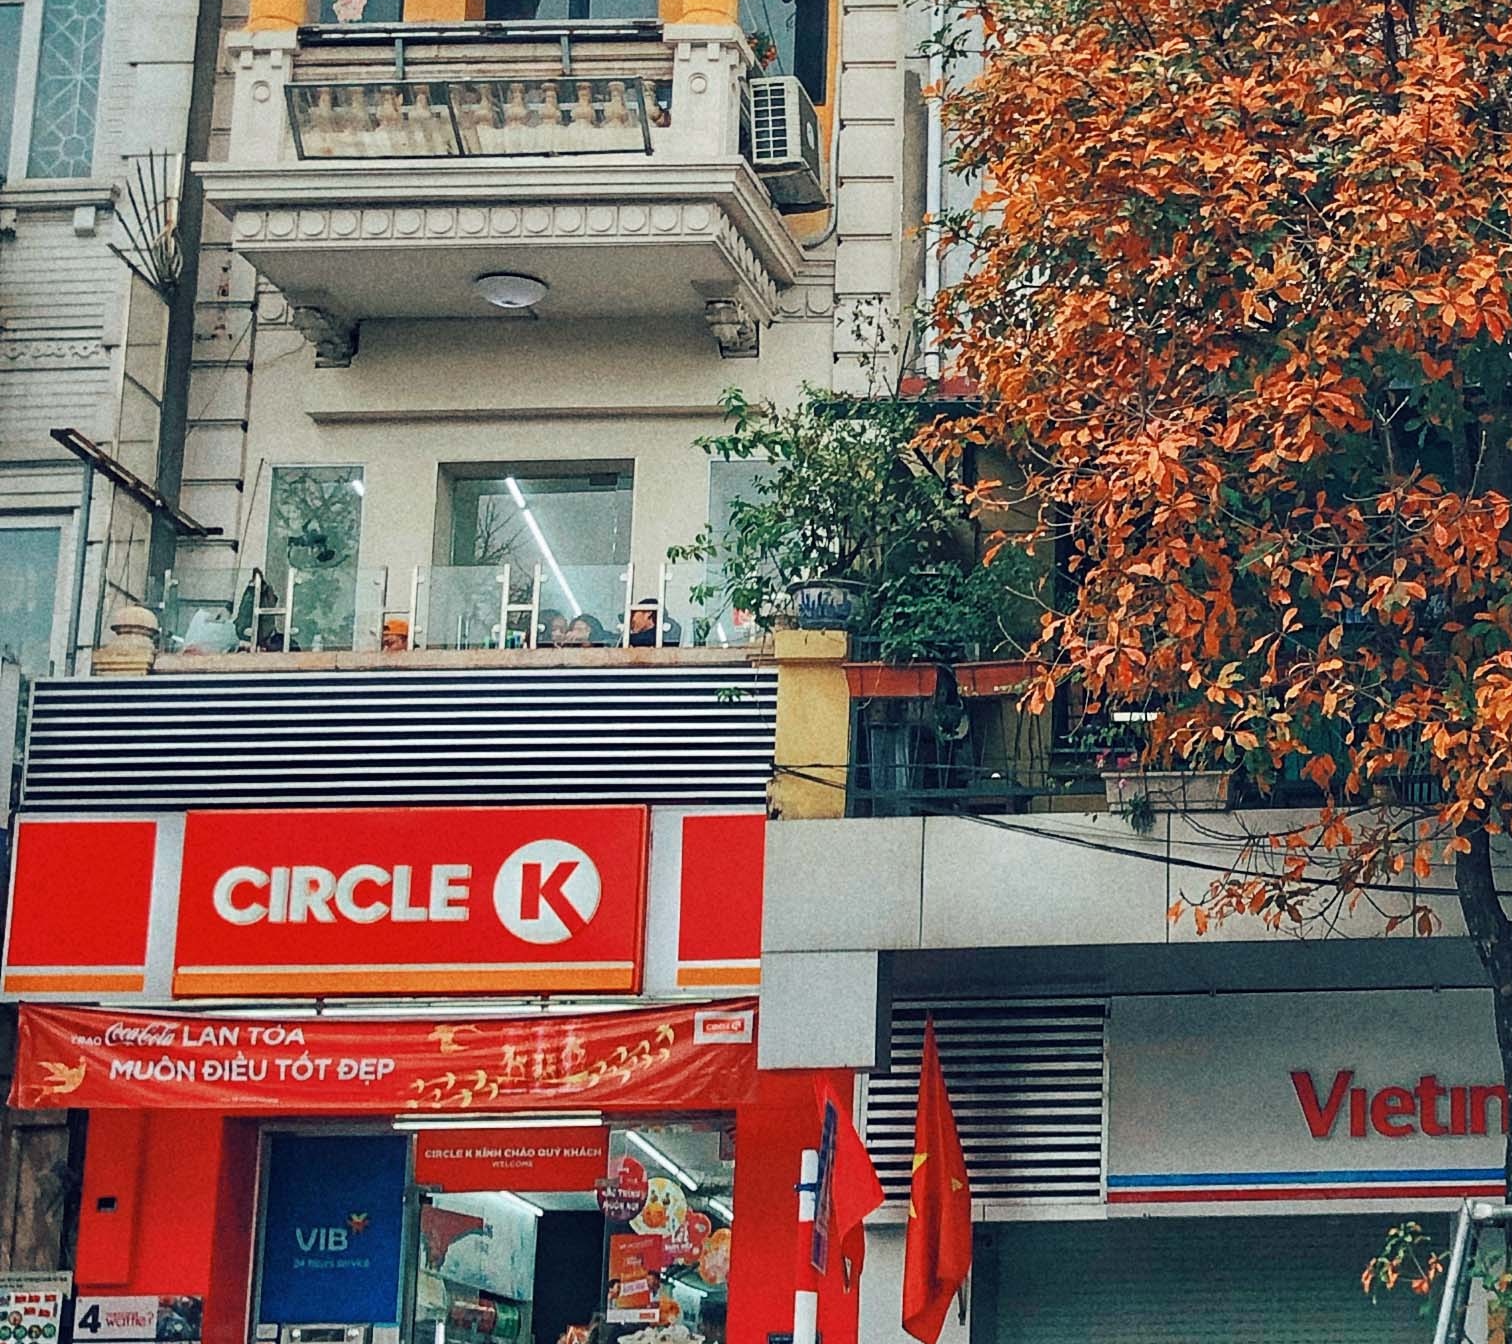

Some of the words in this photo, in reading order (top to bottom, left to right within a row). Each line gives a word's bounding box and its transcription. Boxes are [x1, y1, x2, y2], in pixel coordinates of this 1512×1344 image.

[213, 863, 472, 926] CIRCLE
[515, 859, 591, 940] K
[181, 1025, 240, 1047] LAN
[109, 1055, 196, 1082] MUÔN
[201, 1050, 269, 1083] ĐIỀU
[274, 1050, 333, 1082] TỐT
[336, 1057, 396, 1086] ĐẸP
[424, 1148, 463, 1159] CIRCLE
[465, 1148, 473, 1158] K
[295, 1227, 349, 1252] VIB
[78, 1304, 101, 1334] 4
